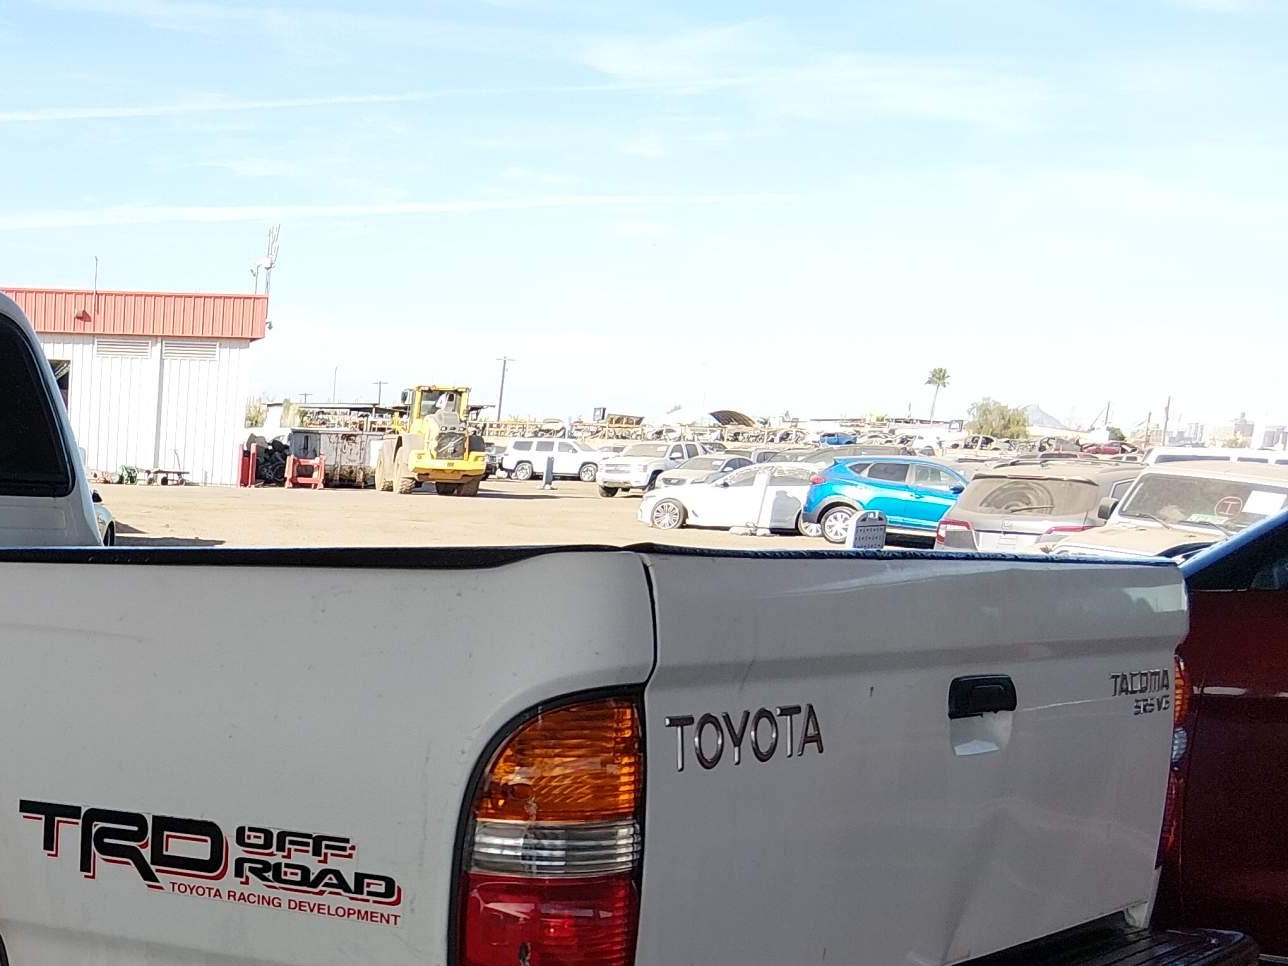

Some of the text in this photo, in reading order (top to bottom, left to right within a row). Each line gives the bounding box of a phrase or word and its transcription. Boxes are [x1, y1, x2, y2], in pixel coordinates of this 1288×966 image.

[1109, 667, 1170, 697] TACOMA
[664, 703, 824, 772] TOYOTA
[18, 799, 229, 890] TRD
[234, 825, 356, 864] OFF
[168, 881, 401, 927] TOYOTA RACING DEVELOPMENT
[234, 856, 402, 907] ROAD
